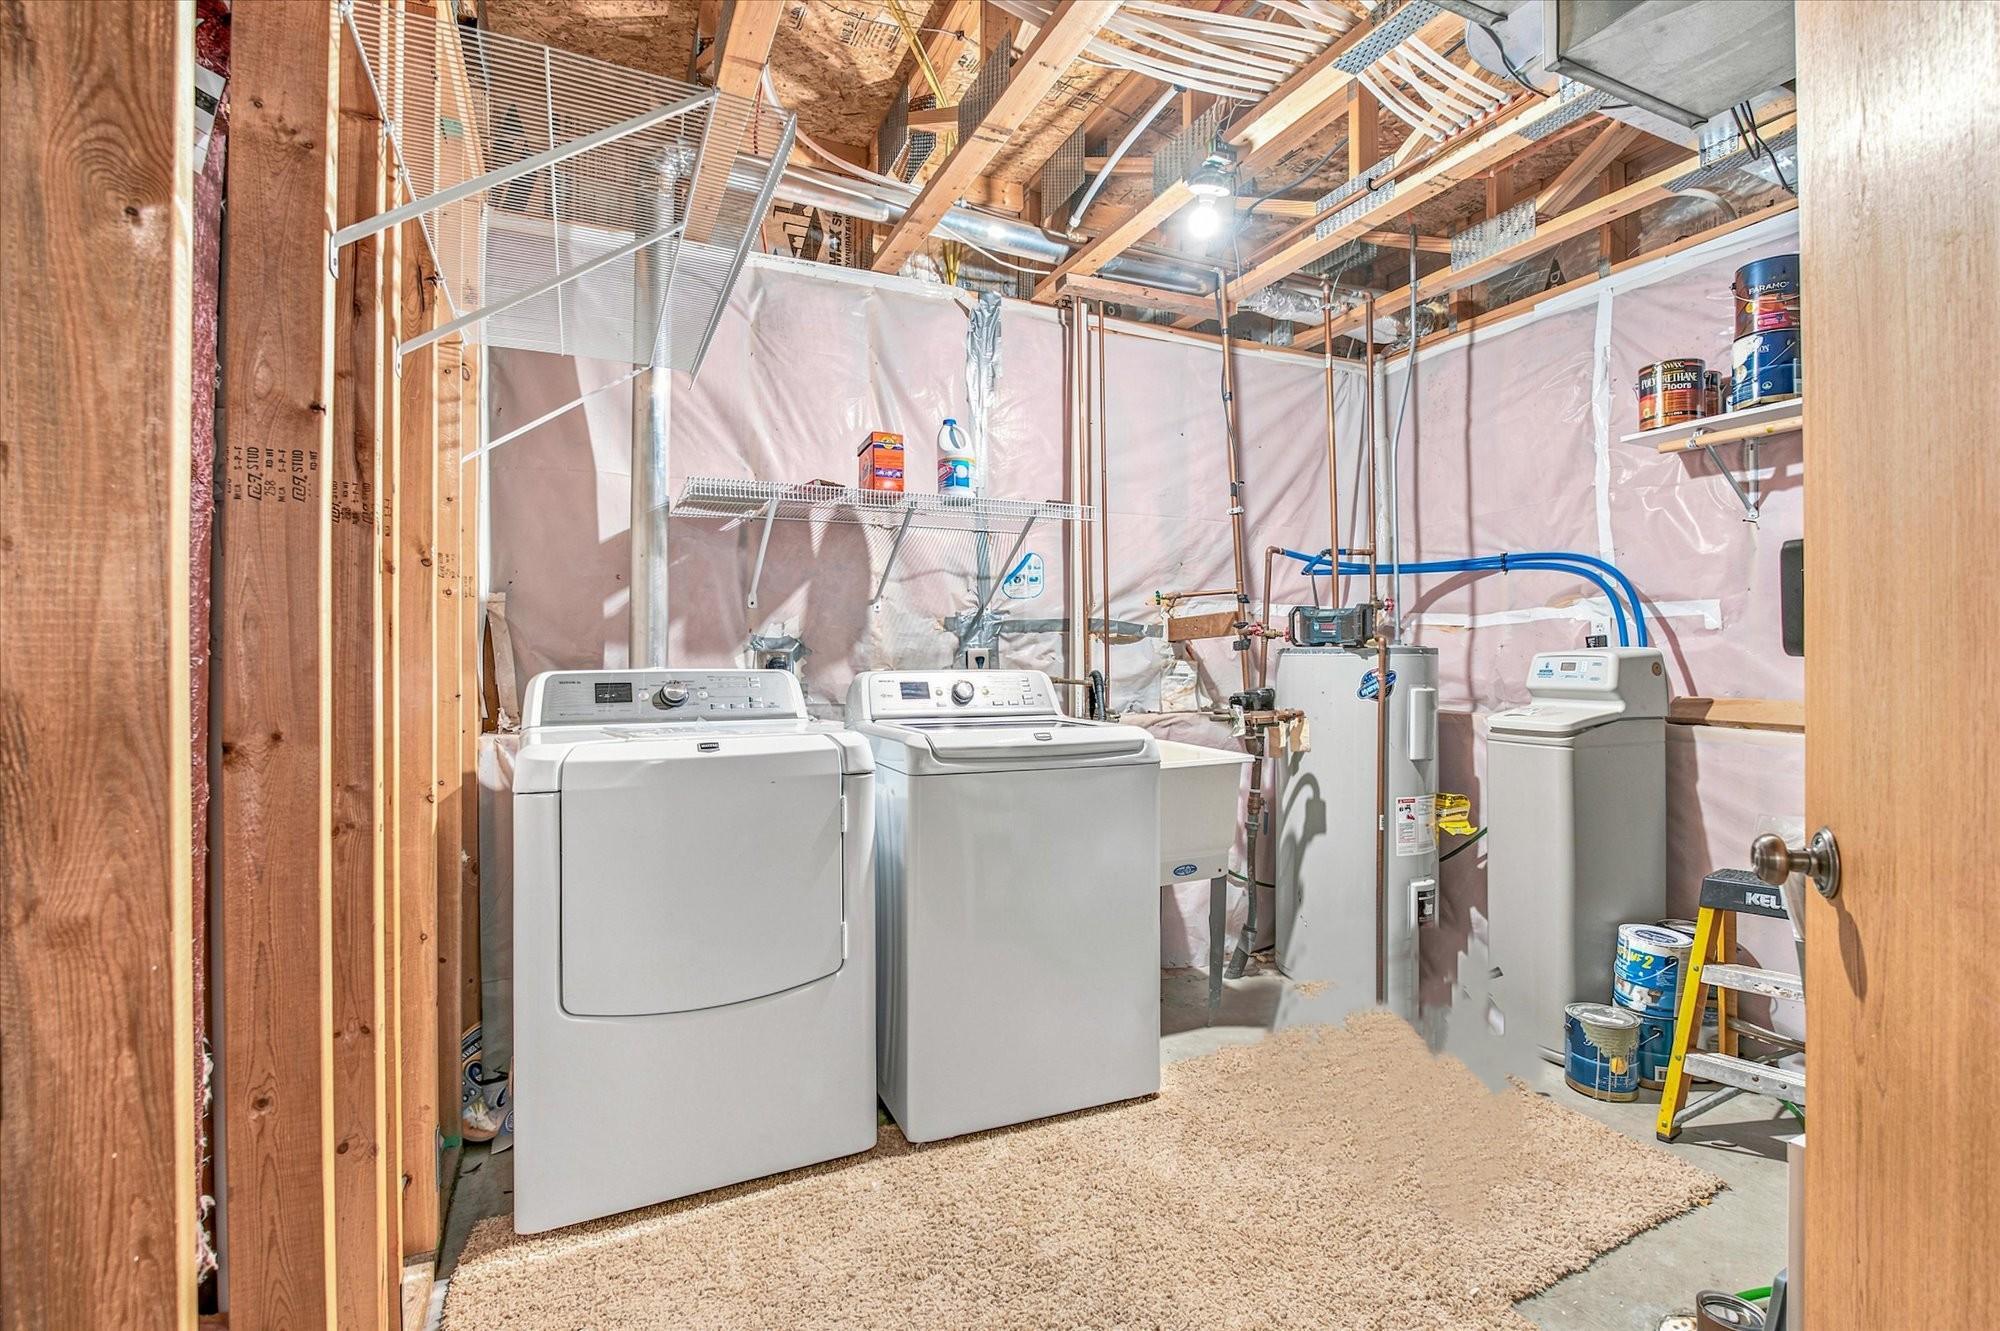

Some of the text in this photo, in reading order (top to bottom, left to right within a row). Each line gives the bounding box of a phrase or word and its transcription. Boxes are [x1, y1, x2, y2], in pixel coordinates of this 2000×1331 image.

[832, 211, 843, 226] SH
[845, 225, 854, 269] YANURATE
[1641, 372, 1698, 390] POLYRETHANE
[233, 446, 243, 471] S-P-F
[246, 446, 260, 471] STUD
[277, 448, 287, 473] S-P-F
[291, 449, 304, 473] STUD
[264, 480, 276, 497] 258
[1745, 891, 1781, 910] KEL
[1642, 955, 1655, 969] 2
